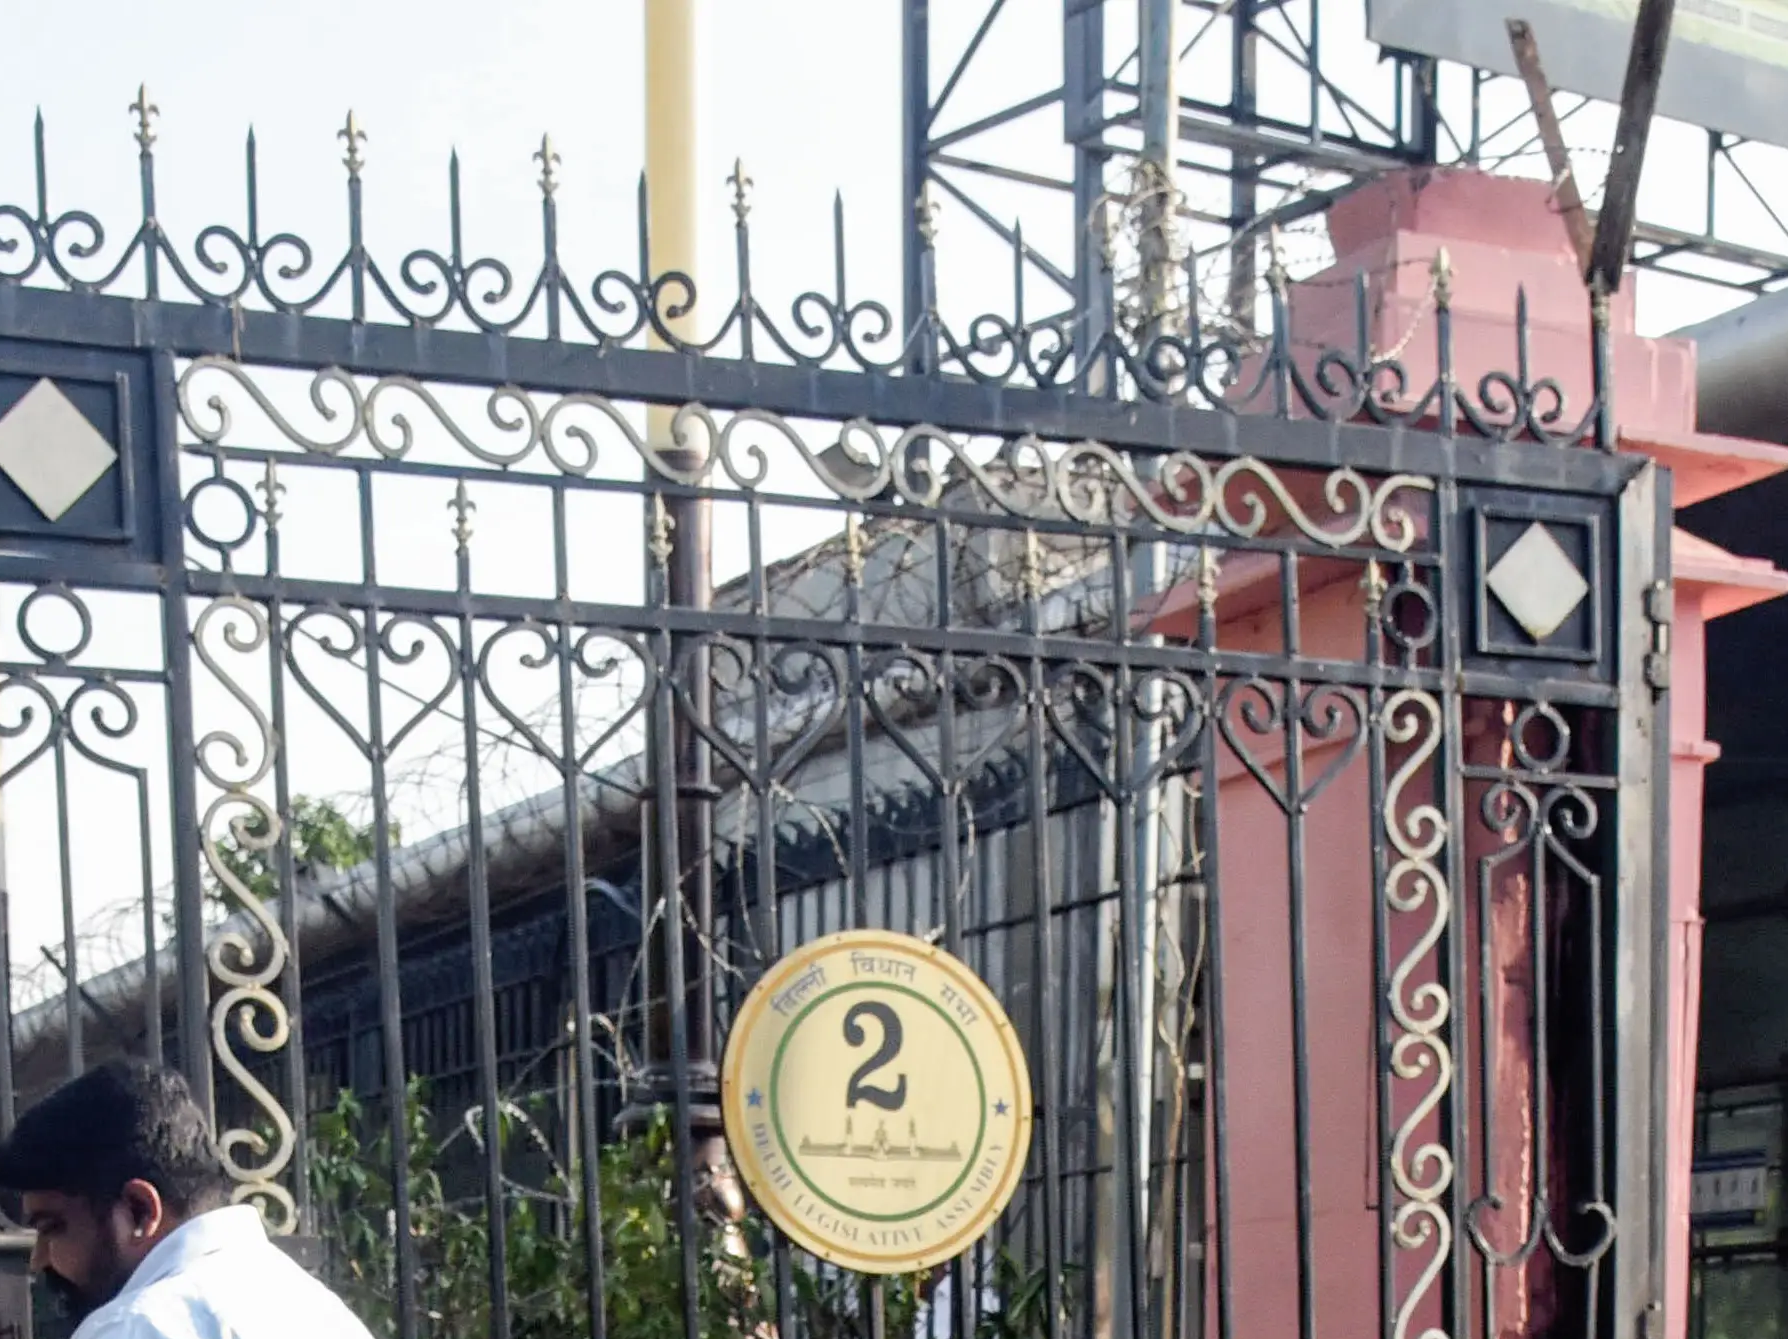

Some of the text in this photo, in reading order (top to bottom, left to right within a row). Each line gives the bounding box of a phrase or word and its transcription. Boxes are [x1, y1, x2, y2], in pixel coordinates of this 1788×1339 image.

[850, 952, 917, 982] विधान
[843, 1001, 907, 1111] 2
[753, 1122, 1004, 1246] DELHI LEGISLATIVE ASSEMBLY
